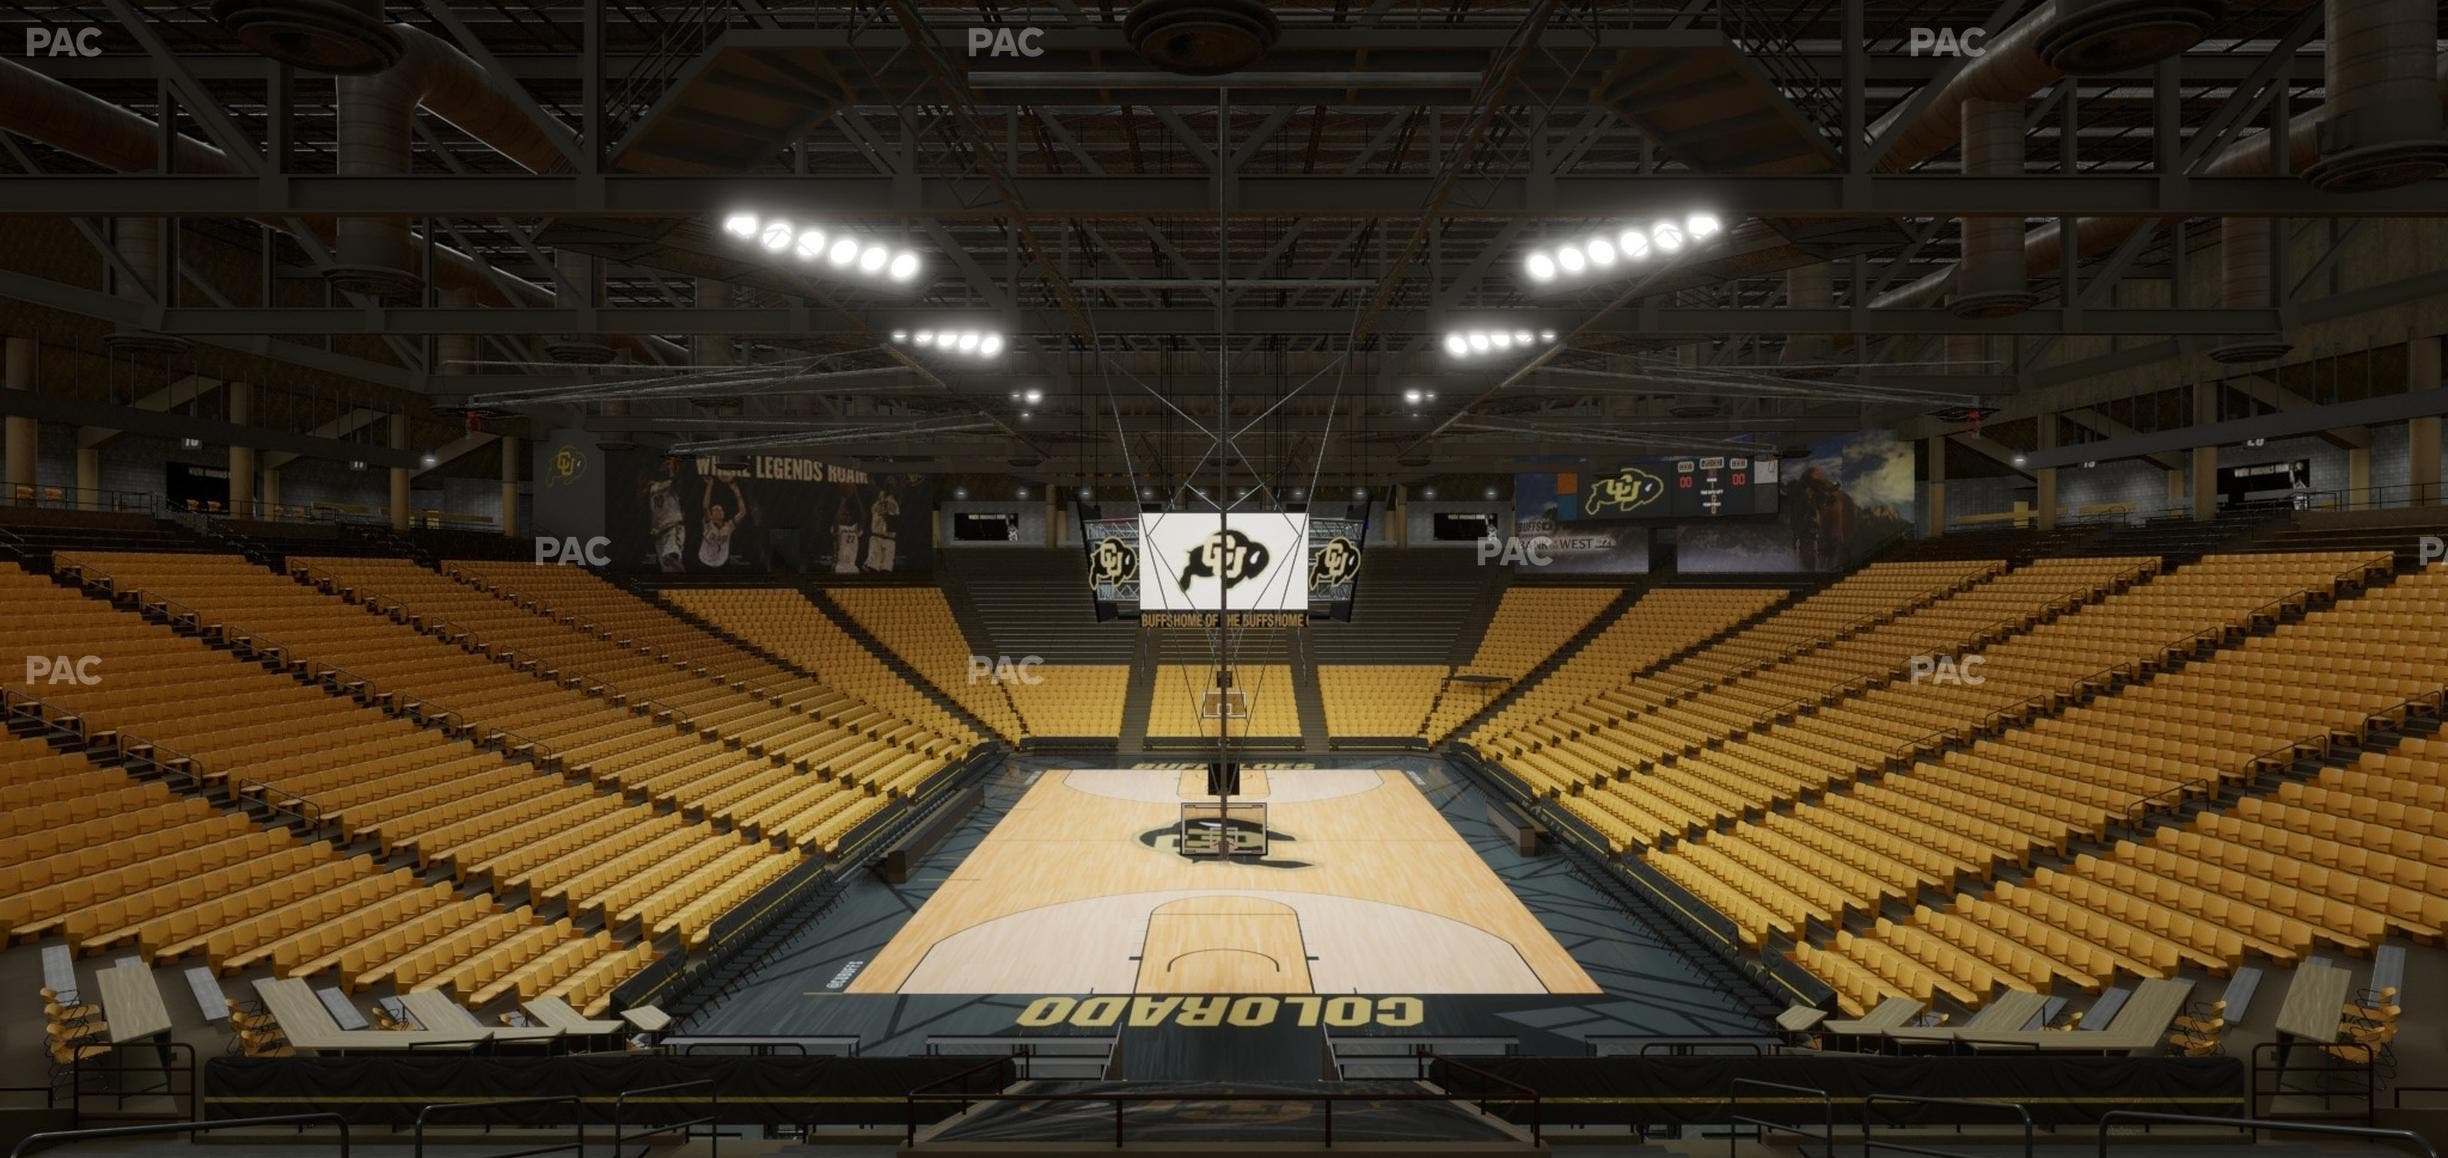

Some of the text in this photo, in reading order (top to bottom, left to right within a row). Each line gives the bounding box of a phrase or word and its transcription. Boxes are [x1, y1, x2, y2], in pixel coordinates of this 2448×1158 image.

[756, 455, 824, 482] LEGENDS
[827, 464, 869, 485] ROAM
[1559, 538, 1594, 550] WEST
[1205, 613, 1219, 628] OF
[1130, 762, 1316, 770] BUFFLOES
[1015, 996, 1424, 1028] COLORADO
